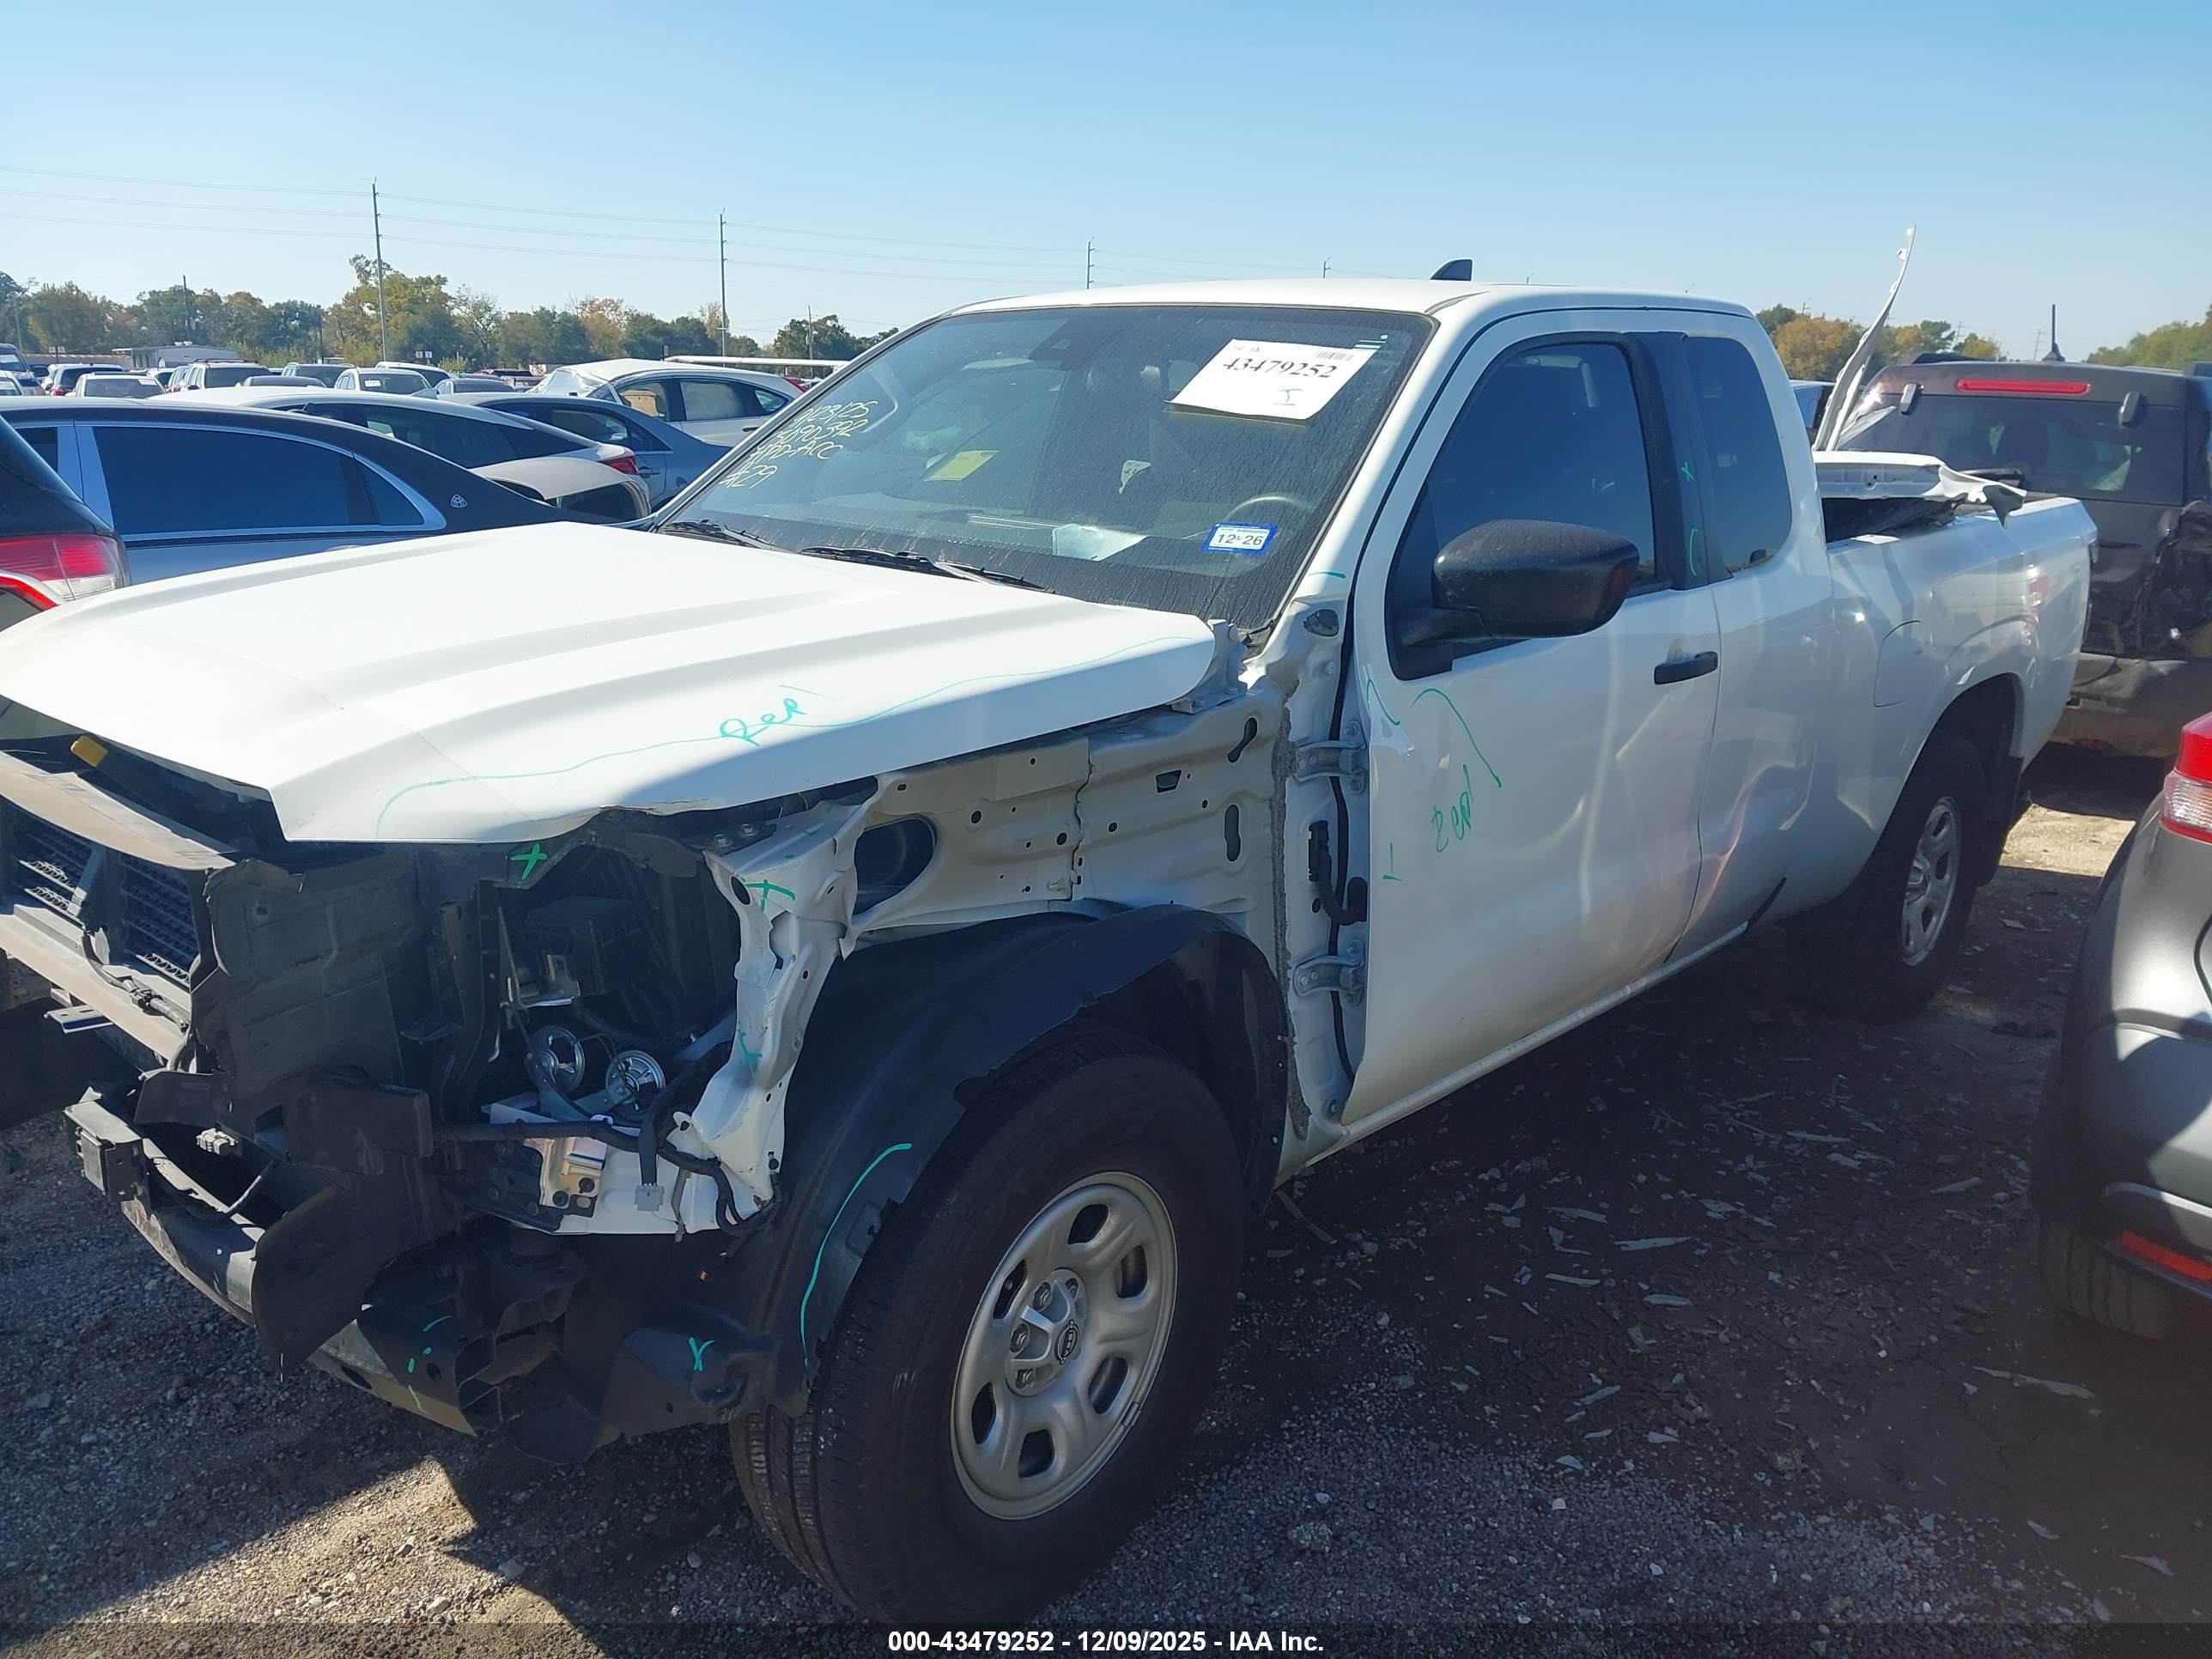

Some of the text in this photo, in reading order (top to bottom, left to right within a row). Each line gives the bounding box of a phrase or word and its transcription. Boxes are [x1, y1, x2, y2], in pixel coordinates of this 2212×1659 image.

[1223, 357, 1338, 378] 43479252
[1218, 533, 1264, 546] 12 26
